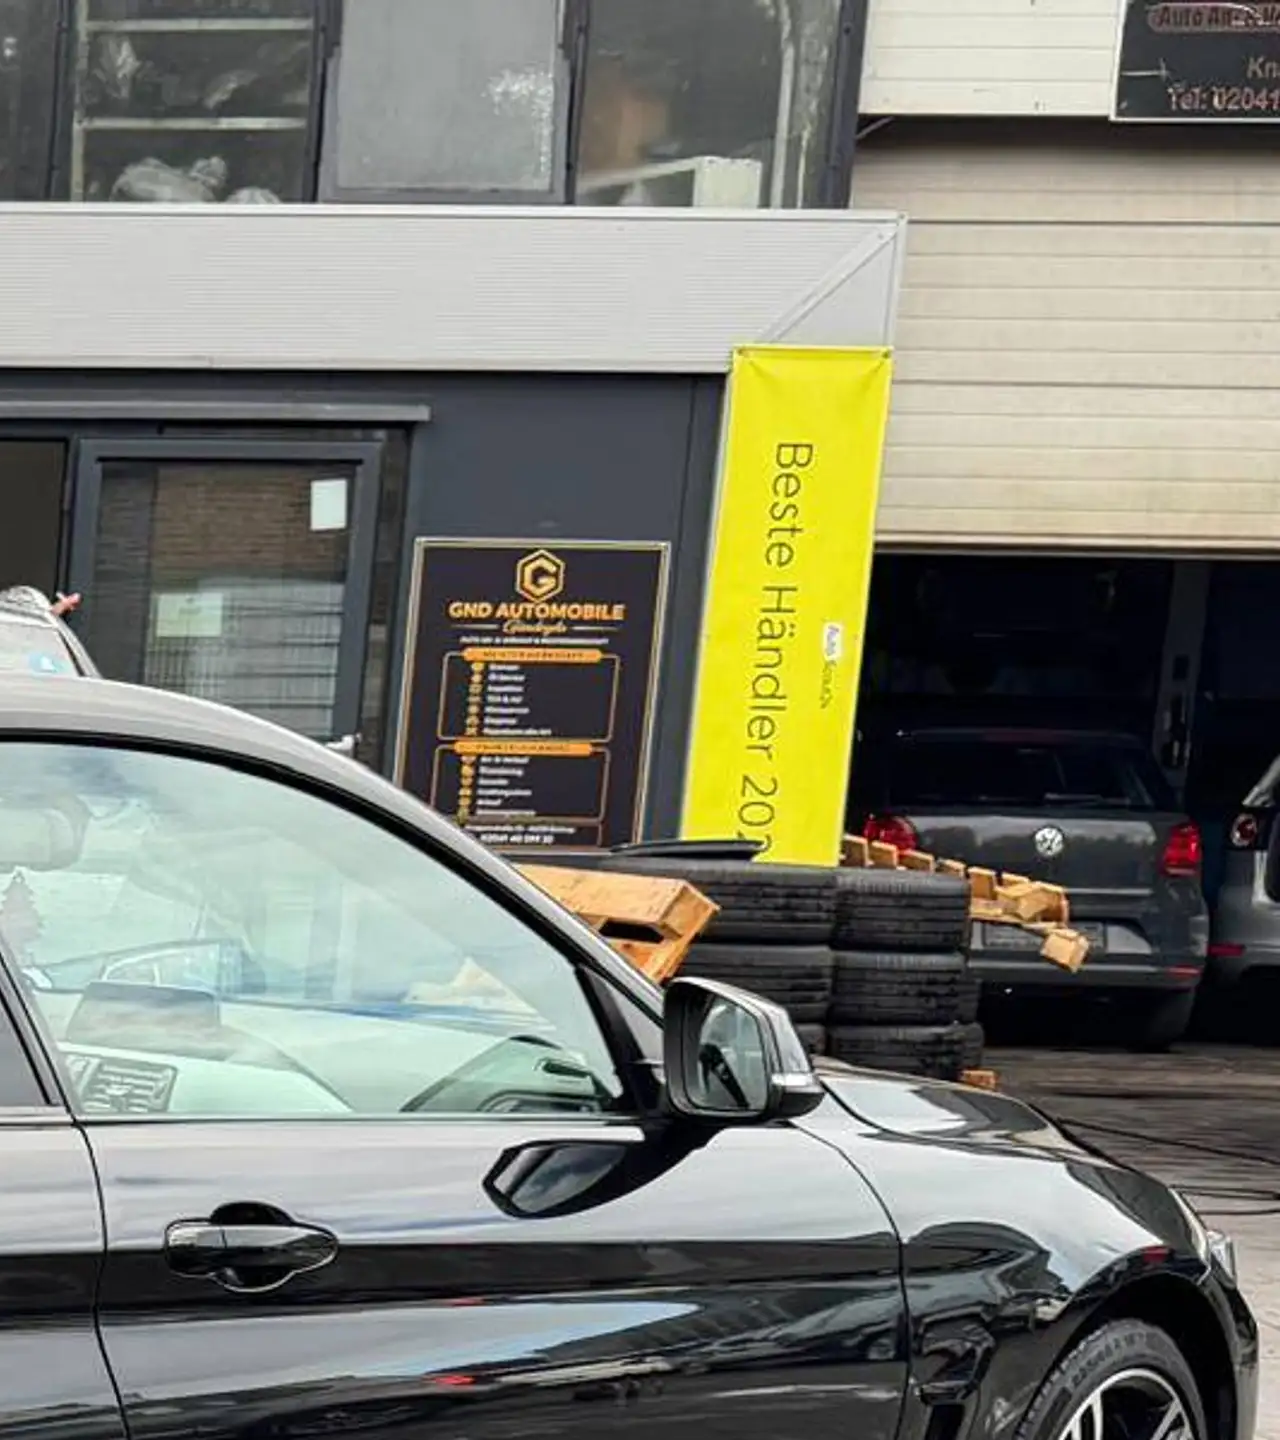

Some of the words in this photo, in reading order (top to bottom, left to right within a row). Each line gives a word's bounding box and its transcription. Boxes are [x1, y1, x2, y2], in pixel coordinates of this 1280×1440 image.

[764, 441, 814, 569] Beste
[448, 601, 493, 619] GND
[495, 602, 626, 621] AUTOMOBILE
[745, 586, 799, 763] Händler
